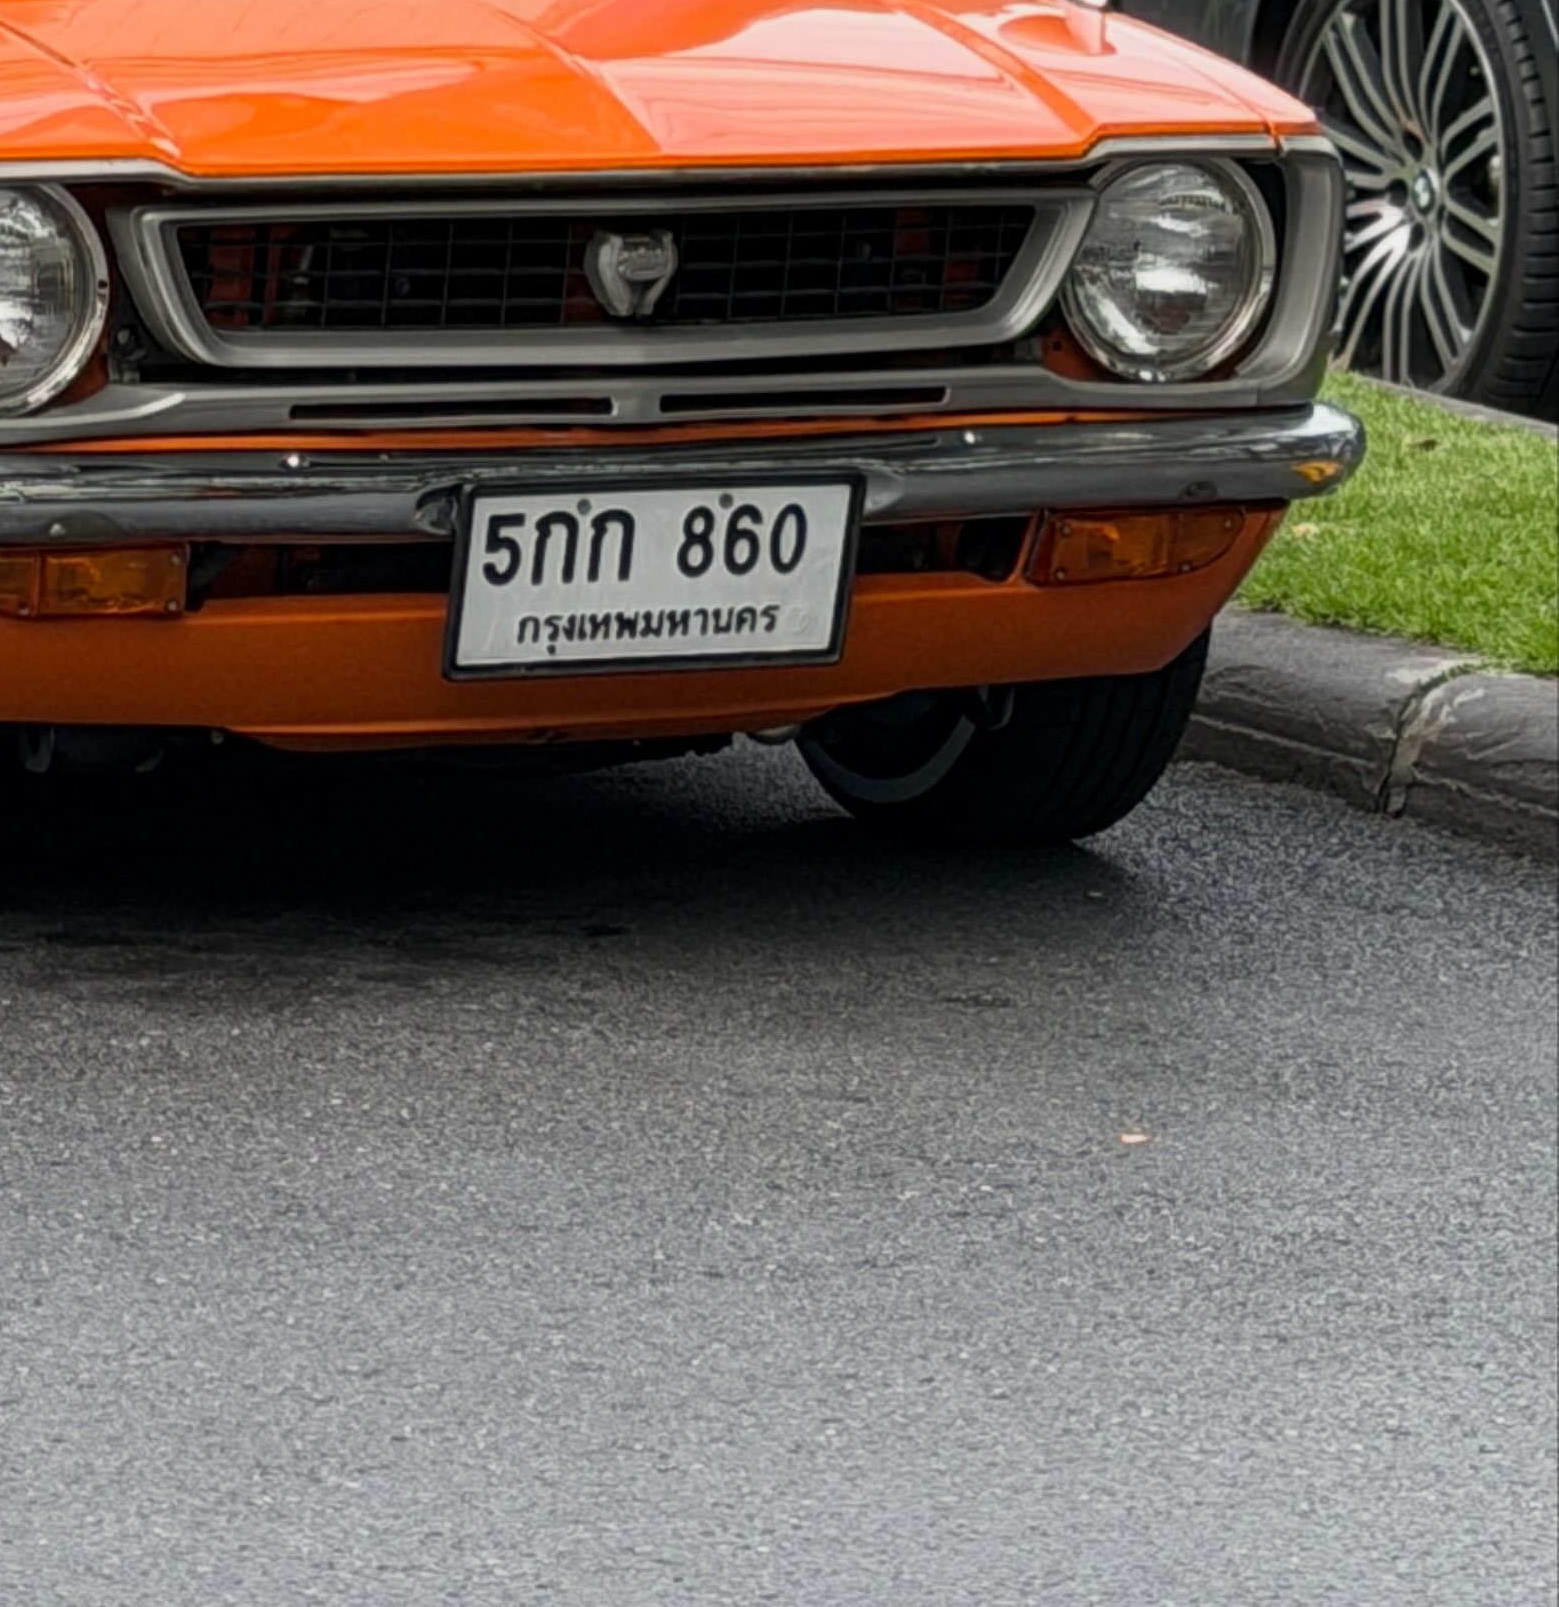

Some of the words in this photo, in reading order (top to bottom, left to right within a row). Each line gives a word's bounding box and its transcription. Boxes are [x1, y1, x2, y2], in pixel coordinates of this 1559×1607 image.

[482, 508, 636, 586] 5กก
[677, 503, 808, 579] 860
[516, 604, 780, 656] กรุงเทพมหานคร
